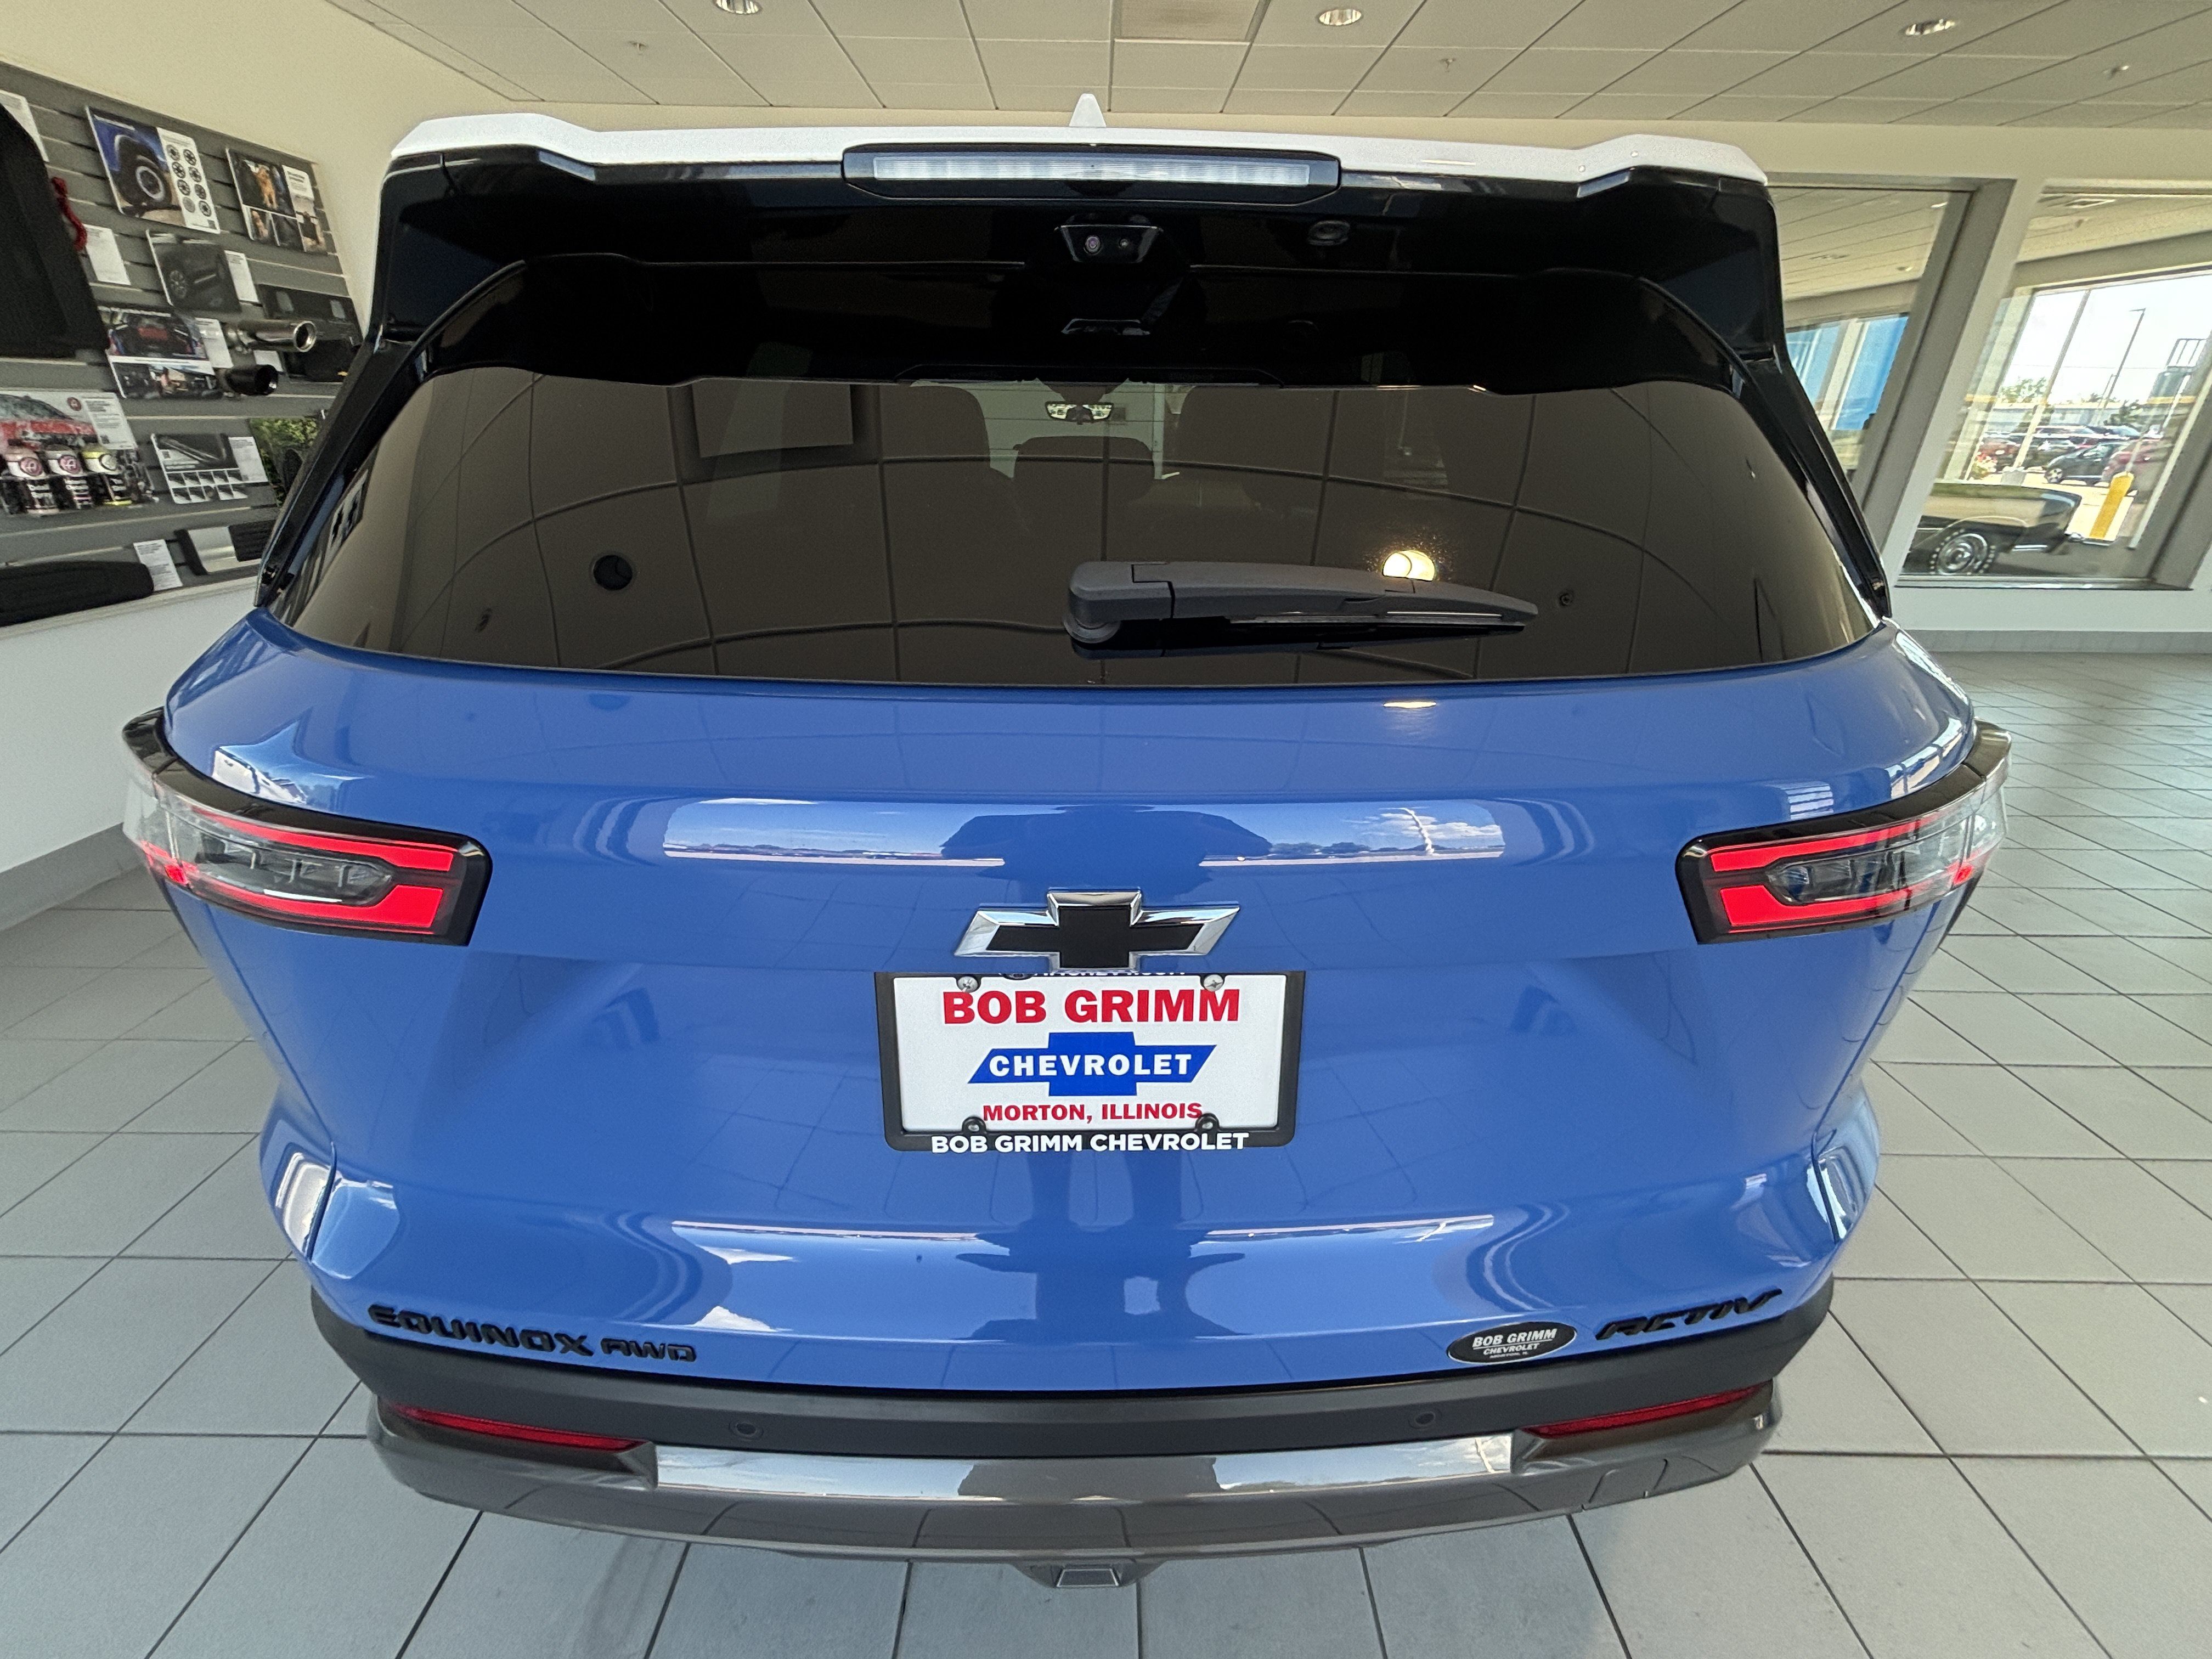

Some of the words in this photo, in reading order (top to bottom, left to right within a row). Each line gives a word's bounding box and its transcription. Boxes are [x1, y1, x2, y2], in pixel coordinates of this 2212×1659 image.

[943, 990, 1047, 1024] BOB
[1064, 989, 1239, 1023] GRIMM
[989, 1054, 1192, 1077] CHEVROLET
[983, 1103, 1093, 1124] MORTON,
[1102, 1102, 1203, 1120] ILLINOIS
[931, 1136, 988, 1153] BOB
[995, 1135, 1083, 1153] GRIMM
[1090, 1132, 1250, 1151] CHEVROLET
[1595, 1288, 1782, 1340] ACTIV
[368, 1304, 594, 1357] EQUINOX
[600, 1338, 697, 1362] AWD
[1472, 1334, 1504, 1347] BOB
[1506, 1328, 1558, 1344] GRIMM
[1483, 1342, 1540, 1356] CHEVROLET
